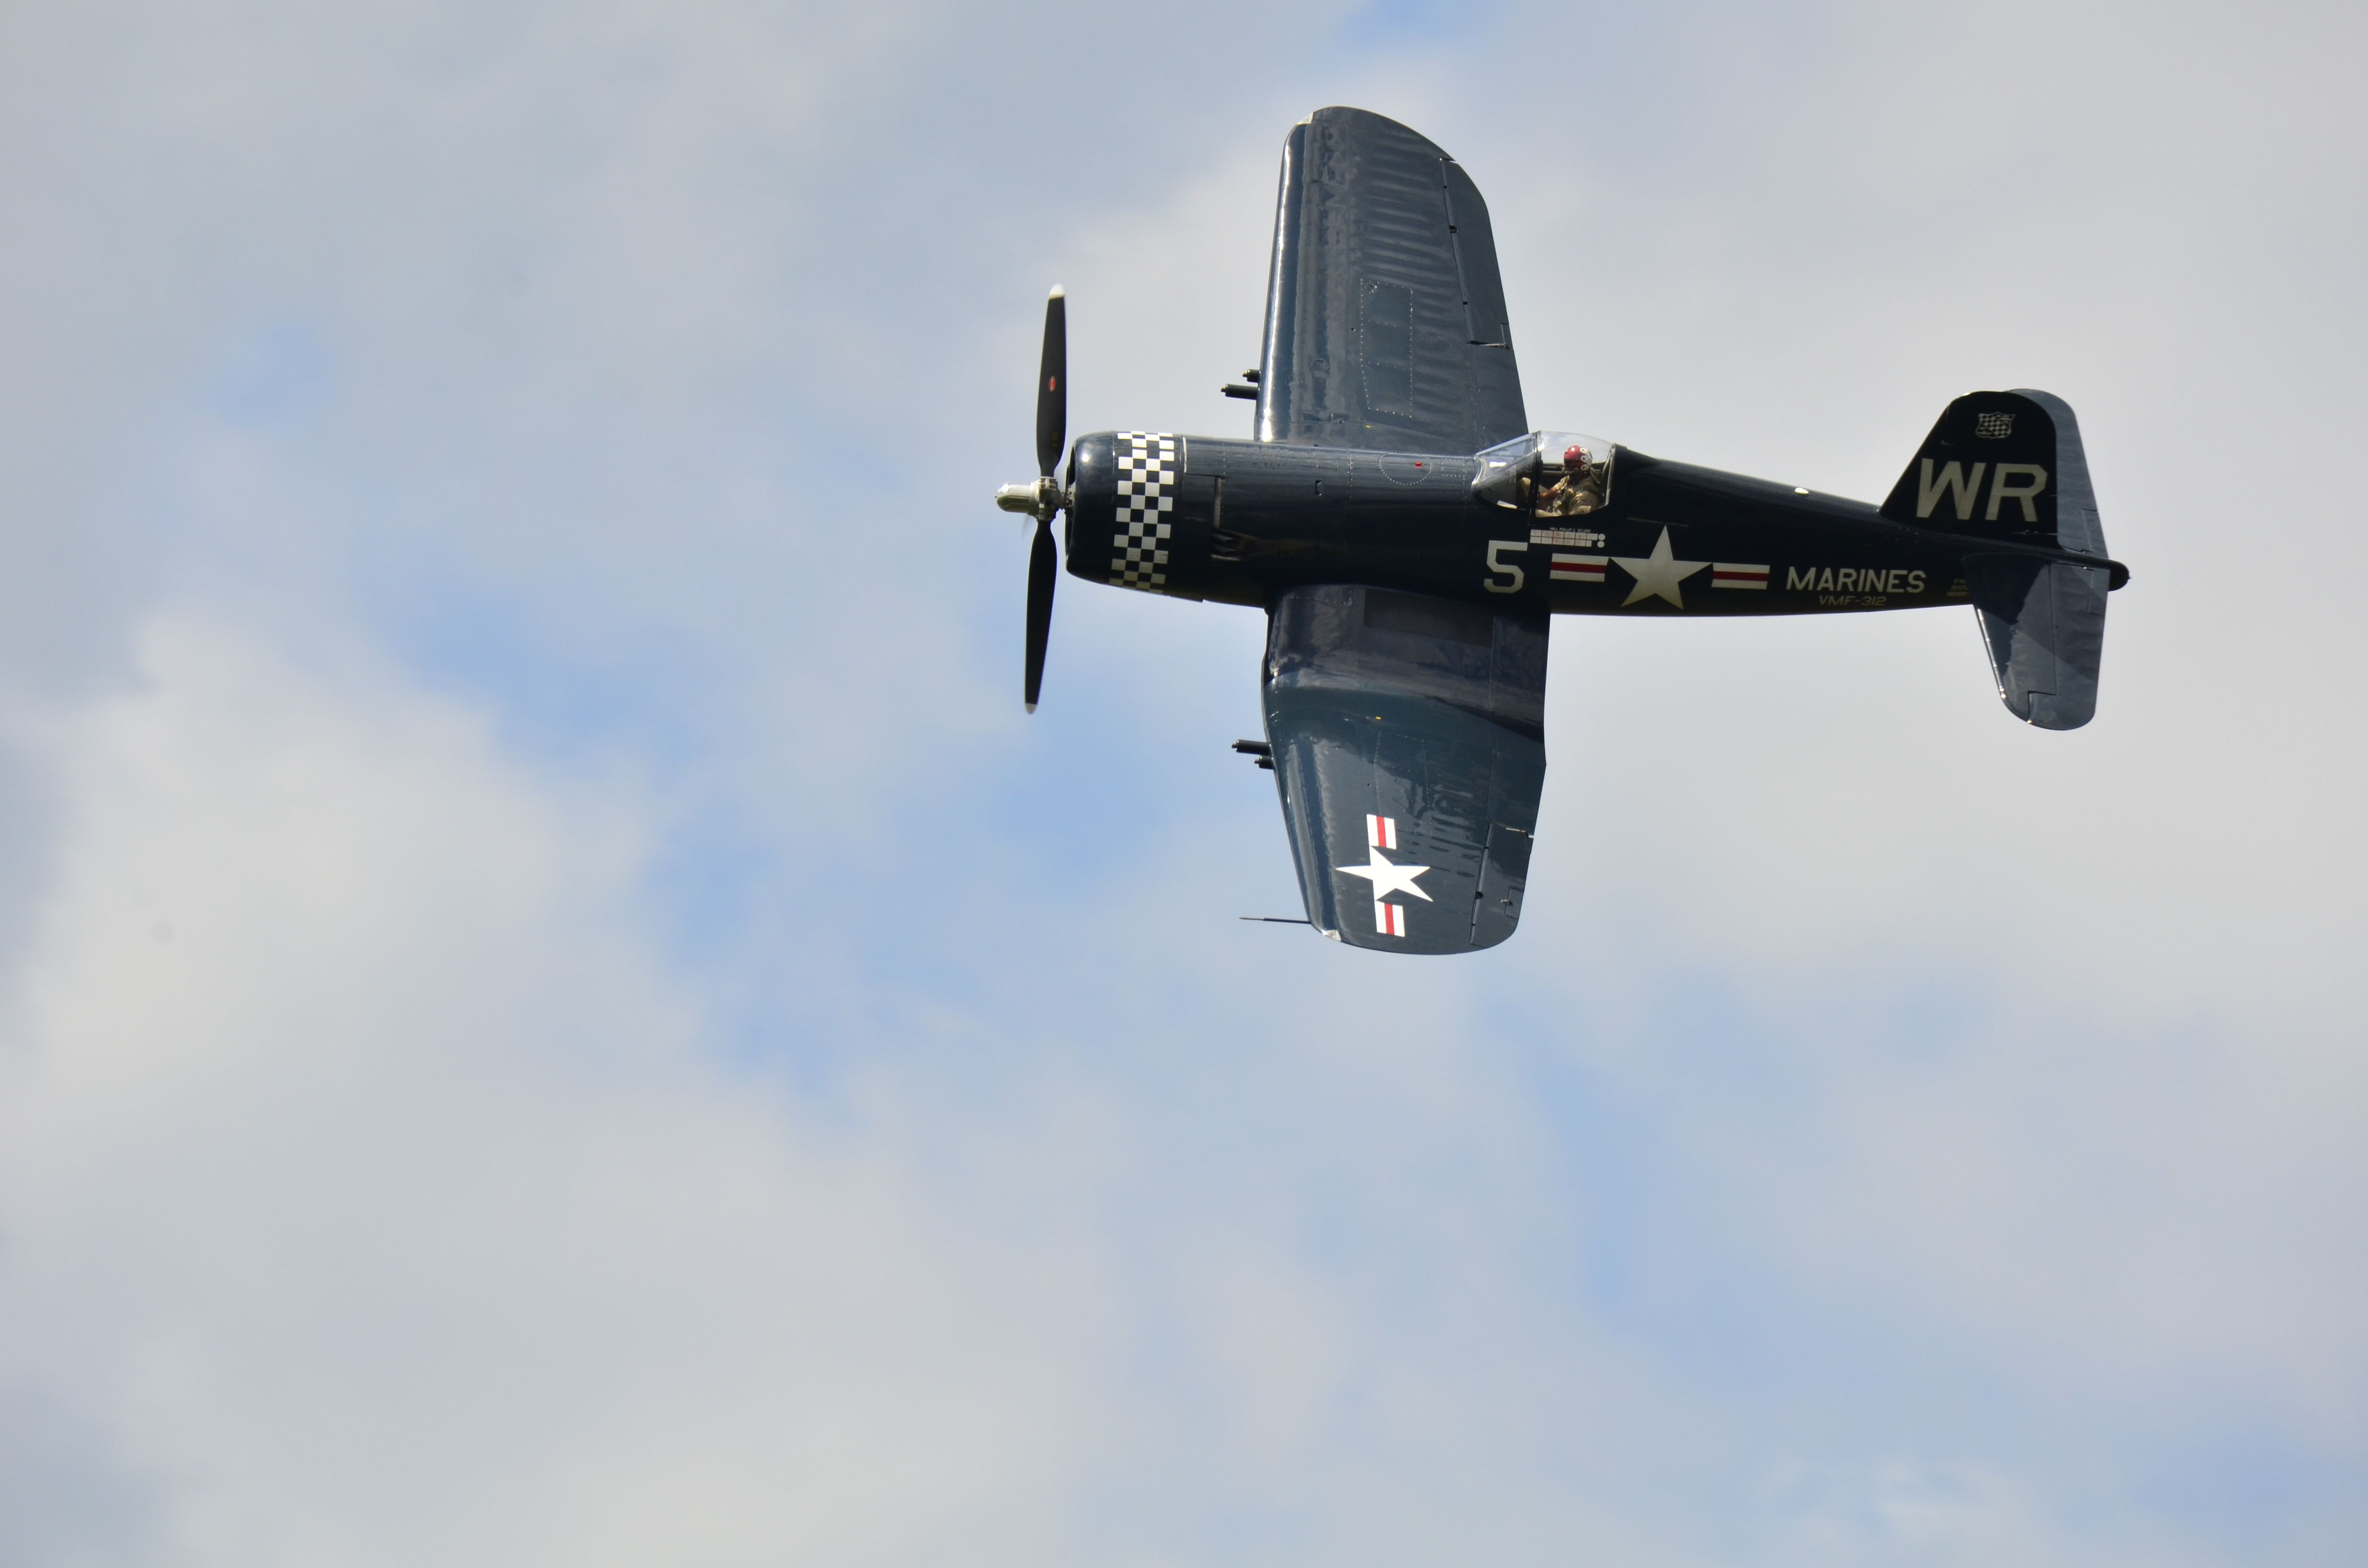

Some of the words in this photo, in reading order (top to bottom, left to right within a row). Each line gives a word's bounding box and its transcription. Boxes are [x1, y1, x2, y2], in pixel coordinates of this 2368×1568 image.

[1916, 458, 2048, 522] WR
[1483, 540, 1528, 594] 5
[1786, 566, 1926, 593] MARINES
[1819, 595, 1887, 606] VMF-312
